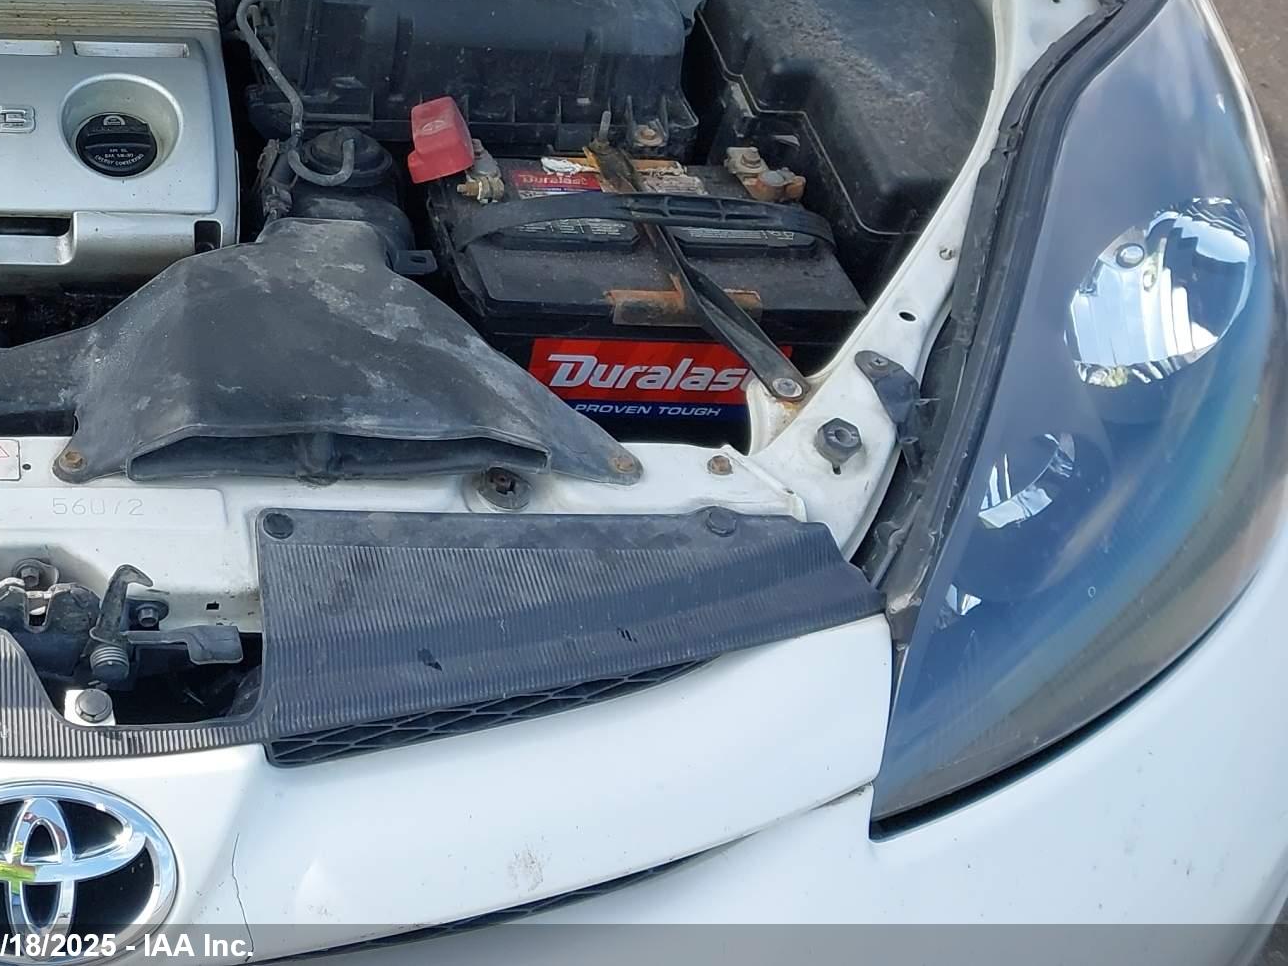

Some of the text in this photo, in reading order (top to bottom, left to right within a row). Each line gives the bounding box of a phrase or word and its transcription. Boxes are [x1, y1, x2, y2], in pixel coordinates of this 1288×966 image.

[519, 174, 588, 186] Duralast
[575, 403, 722, 416] PROVEN TOUGH
